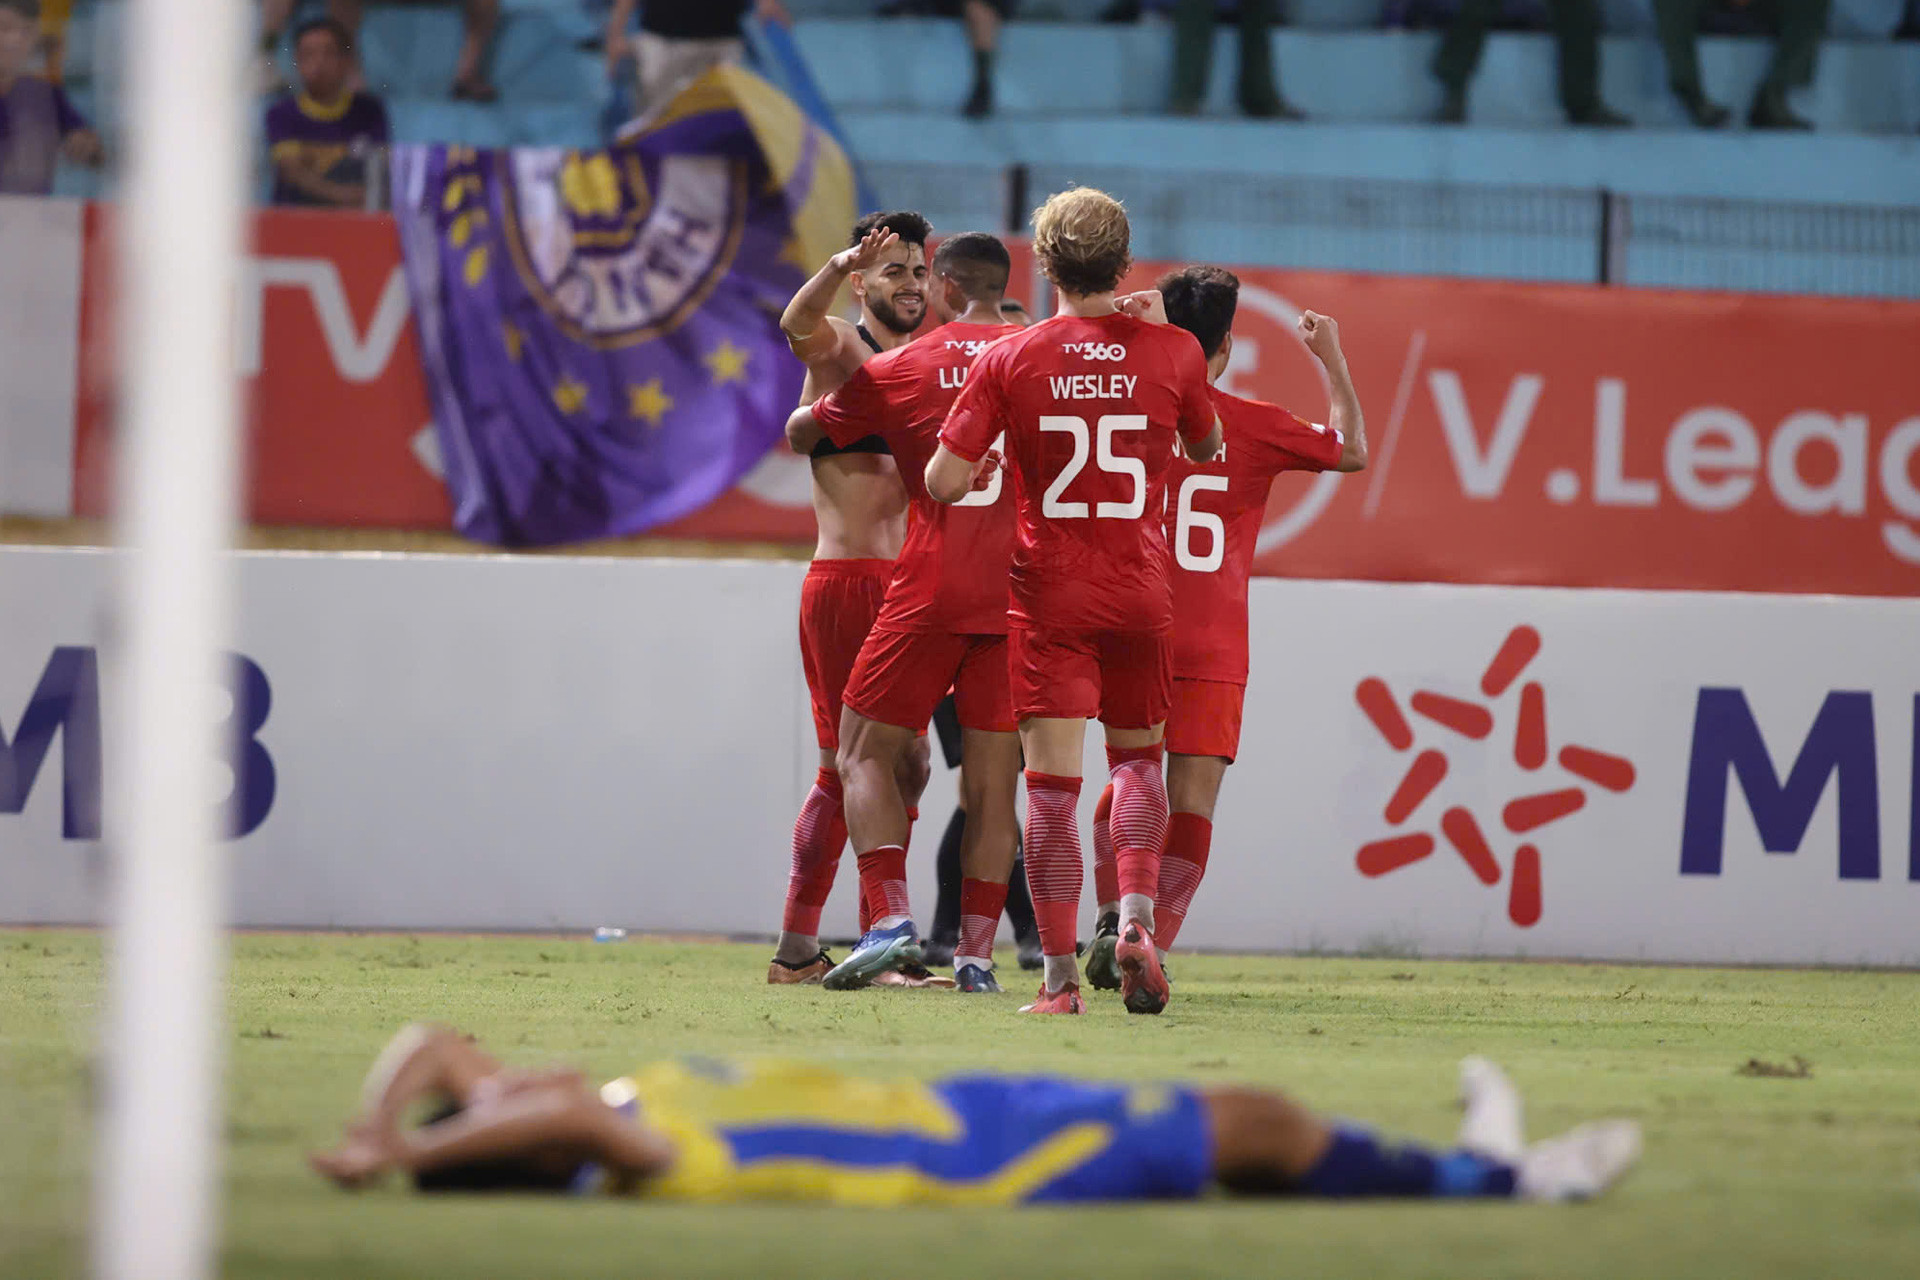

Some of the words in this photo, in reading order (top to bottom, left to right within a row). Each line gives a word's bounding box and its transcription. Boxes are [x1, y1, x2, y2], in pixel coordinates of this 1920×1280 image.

[1062, 342, 1127, 361] TV360
[1049, 374, 1137, 399] WESLEY
[1039, 414, 1148, 519] 25
[1680, 687, 1920, 881] M
